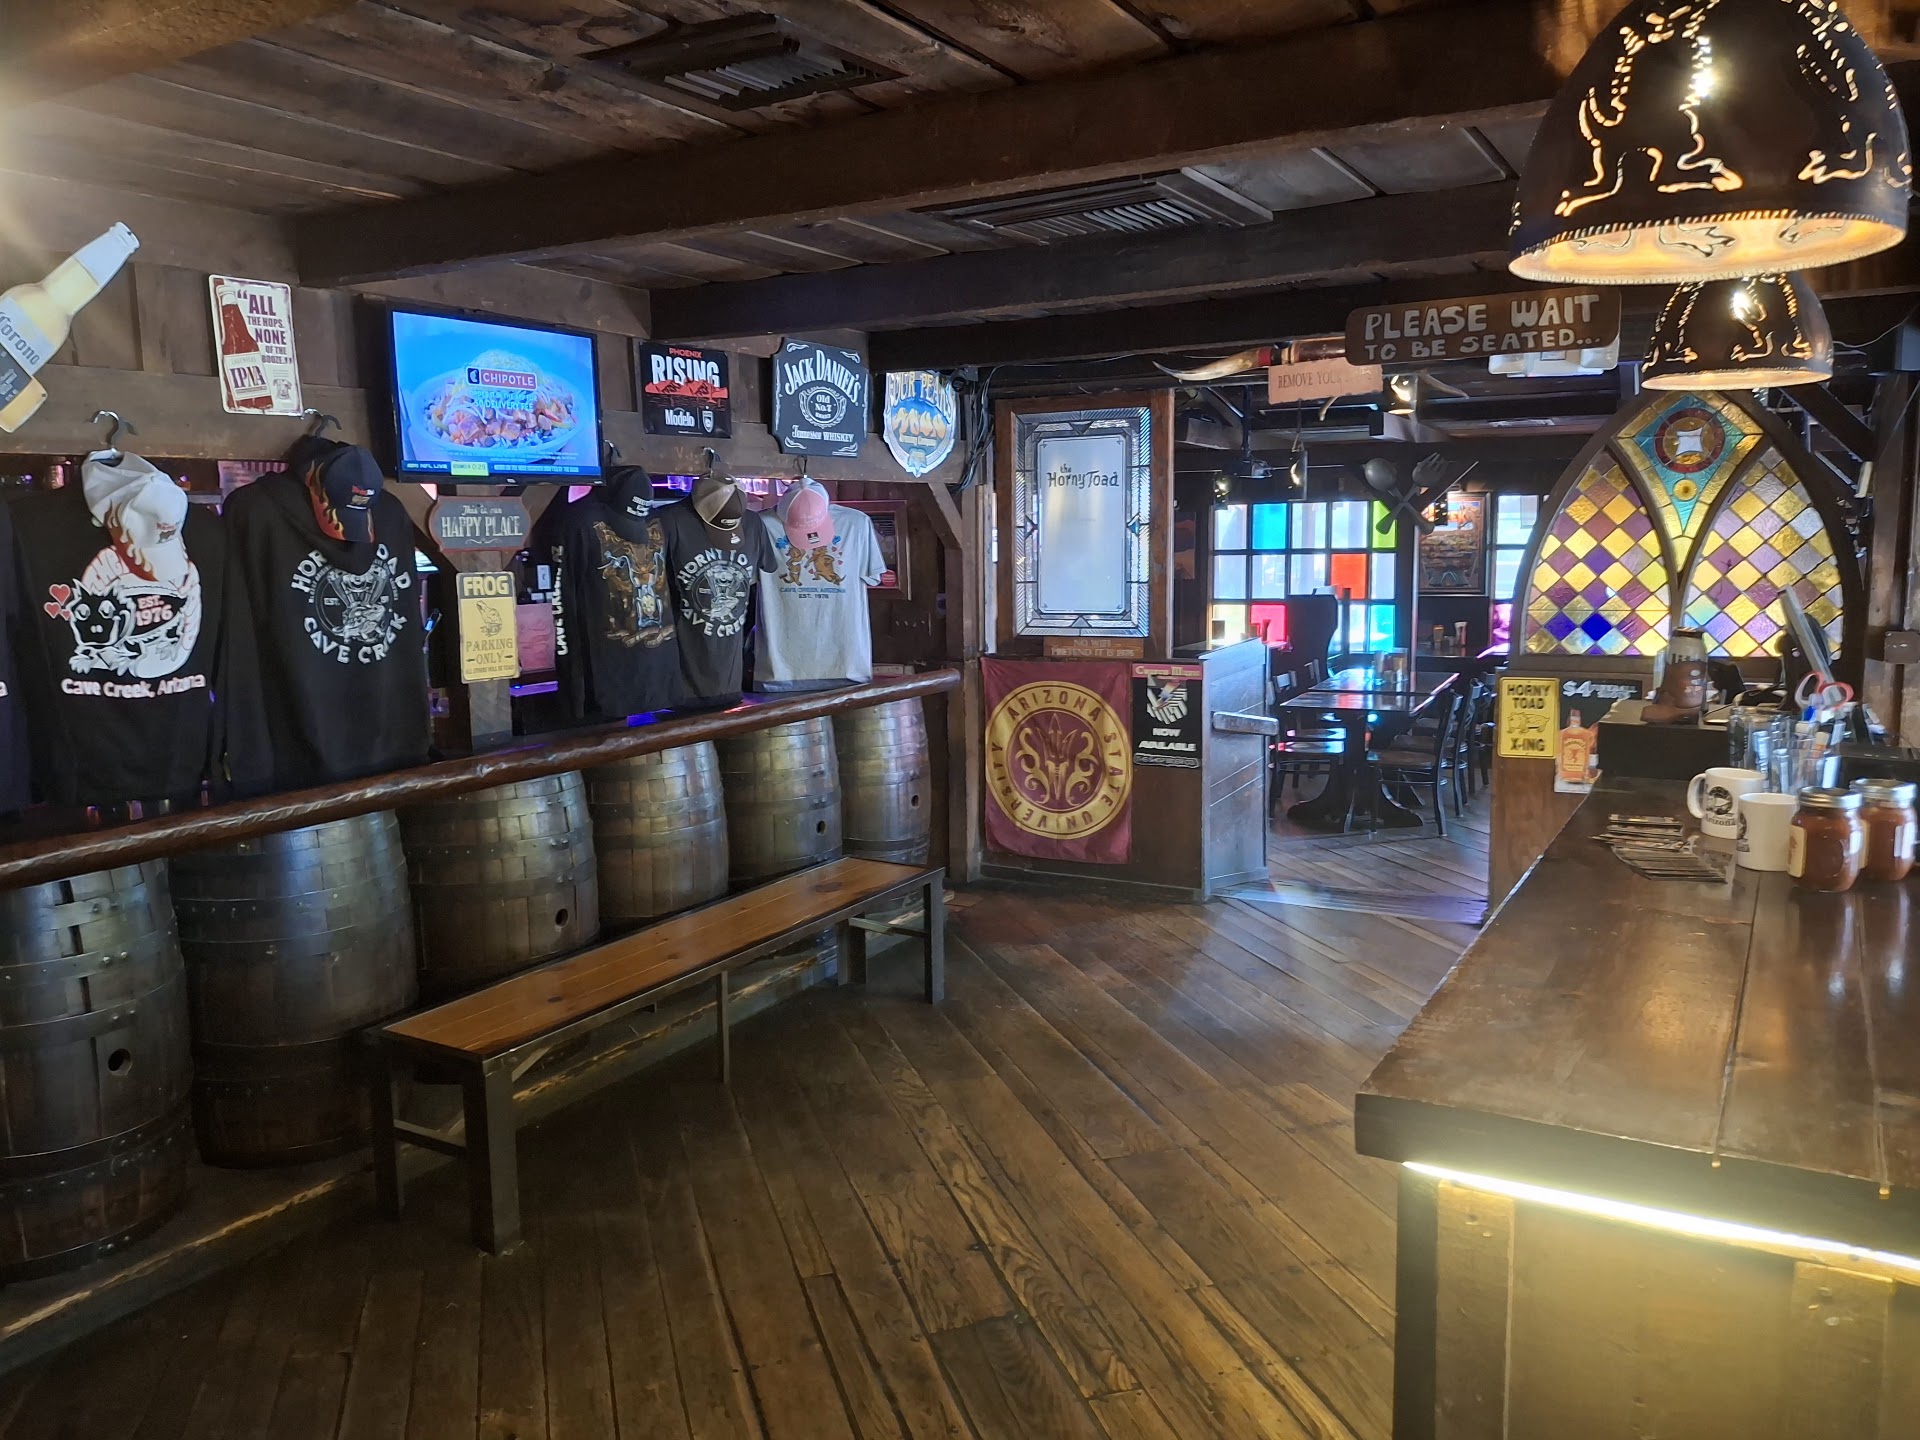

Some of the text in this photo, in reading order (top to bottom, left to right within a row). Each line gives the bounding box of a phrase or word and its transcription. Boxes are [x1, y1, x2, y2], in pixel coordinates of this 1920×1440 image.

[1365, 294, 1600, 341] PLEASE WAIT
[254, 328, 286, 345] NONE
[1365, 328, 1601, 360] TO BE SEATED...
[669, 348, 702, 359] PHOENIX
[483, 372, 534, 387] CHIPOTLE
[651, 354, 720, 388] RISING
[784, 350, 861, 403] JACK DANIEL'S
[1278, 371, 1313, 388] REMOVE
[665, 408, 695, 427] Modelo
[823, 432, 854, 442] WHISKEY
[1060, 463, 1072, 473] the
[1046, 470, 1119, 489] Horny Toad
[441, 516, 523, 538] HAPPY PLACE
[291, 549, 328, 593] HOR
[677, 547, 723, 584] HORNY
[463, 577, 509, 596] FROG
[137, 596, 164, 608] EST.
[135, 606, 173, 627] 1976
[304, 616, 351, 664] CAVE
[466, 638, 513, 653] PARKING
[1074, 639, 1088, 647] NO
[476, 652, 503, 666] ONLY
[1051, 647, 1092, 656] PRETEND
[1094, 648, 1104, 656] IT
[1106, 648, 1114, 656] IS
[61, 678, 102, 697] Cave
[157, 674, 206, 697] Arizona
[1506, 684, 1551, 697] HORNY
[1512, 697, 1545, 709] TOAD
[1152, 728, 1181, 737] NOW
[1138, 740, 1197, 752] AVAILABLE
[1509, 738, 1546, 751] X-ING
[991, 689, 1124, 831] ARIZONA STATE UNIVERSITY
